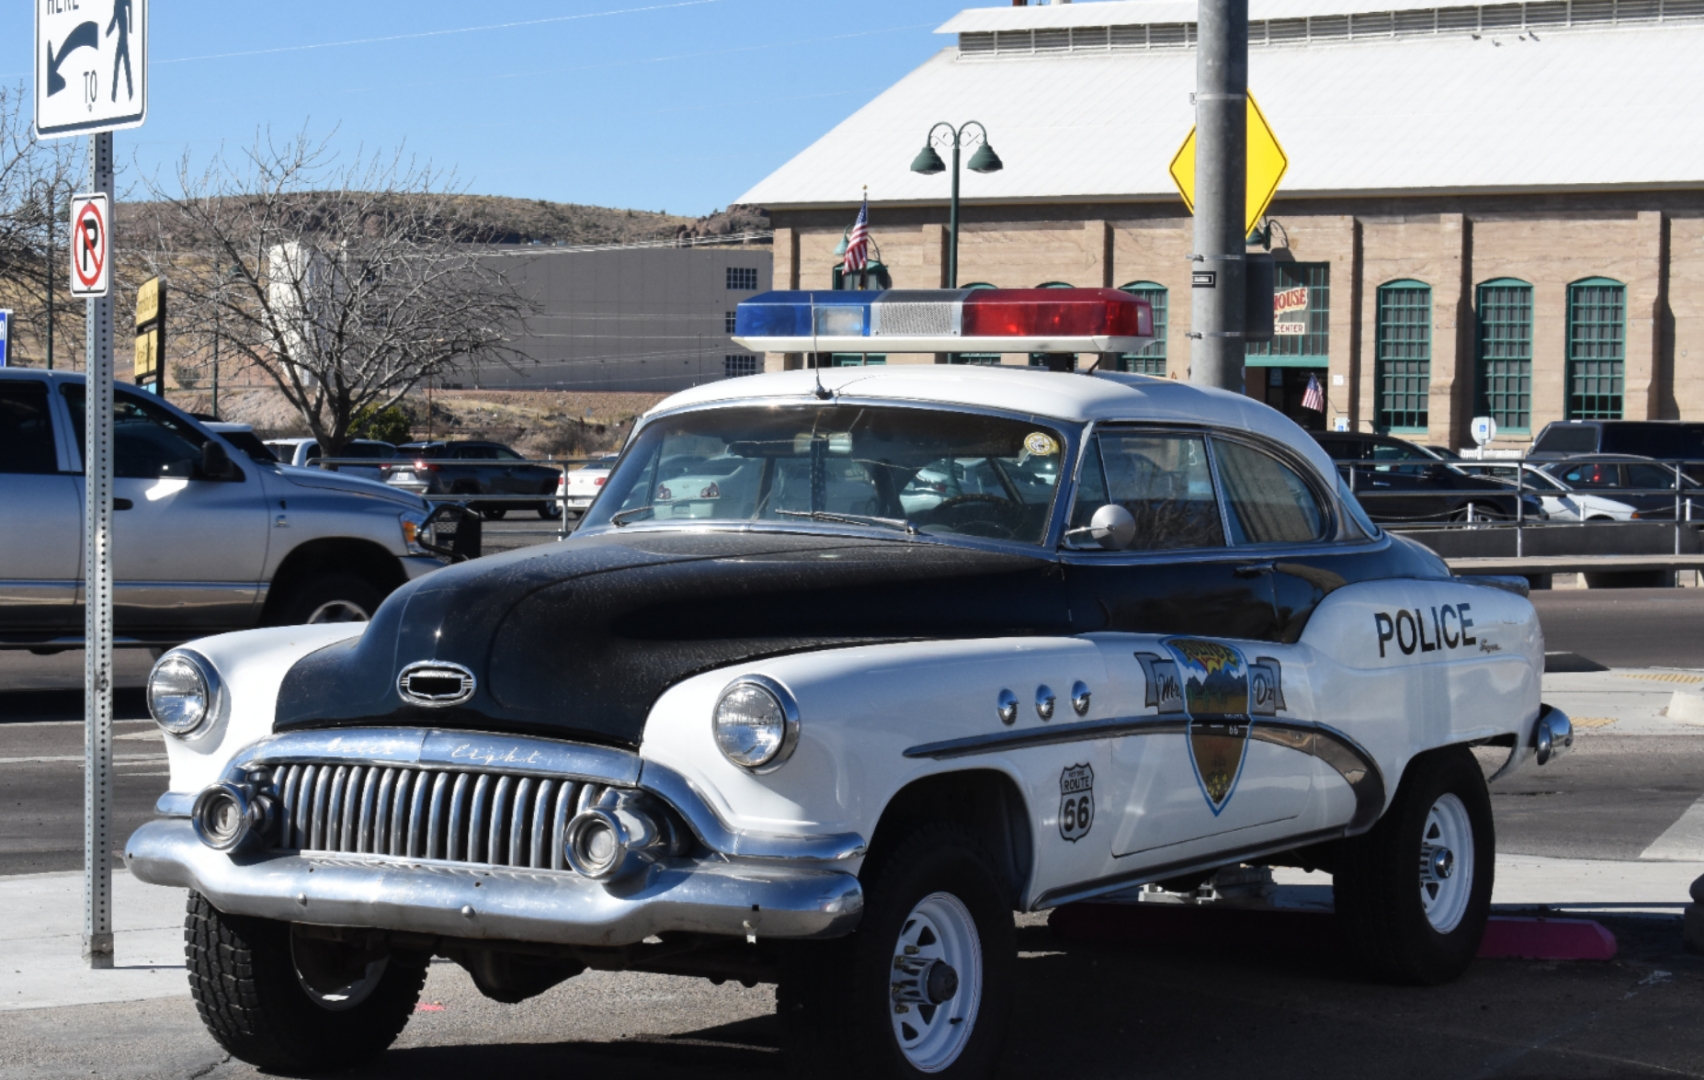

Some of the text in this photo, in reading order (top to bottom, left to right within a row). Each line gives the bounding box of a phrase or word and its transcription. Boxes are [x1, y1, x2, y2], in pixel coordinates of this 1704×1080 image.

[83, 70, 97, 103] TO
[83, 219, 98, 271] P
[1374, 603, 1477, 658] POLICE
[1174, 640, 1237, 668] POLICE
[1229, 725, 1239, 735] 66
[1064, 776, 1090, 791] ROUTE
[1064, 796, 1089, 832] 66
